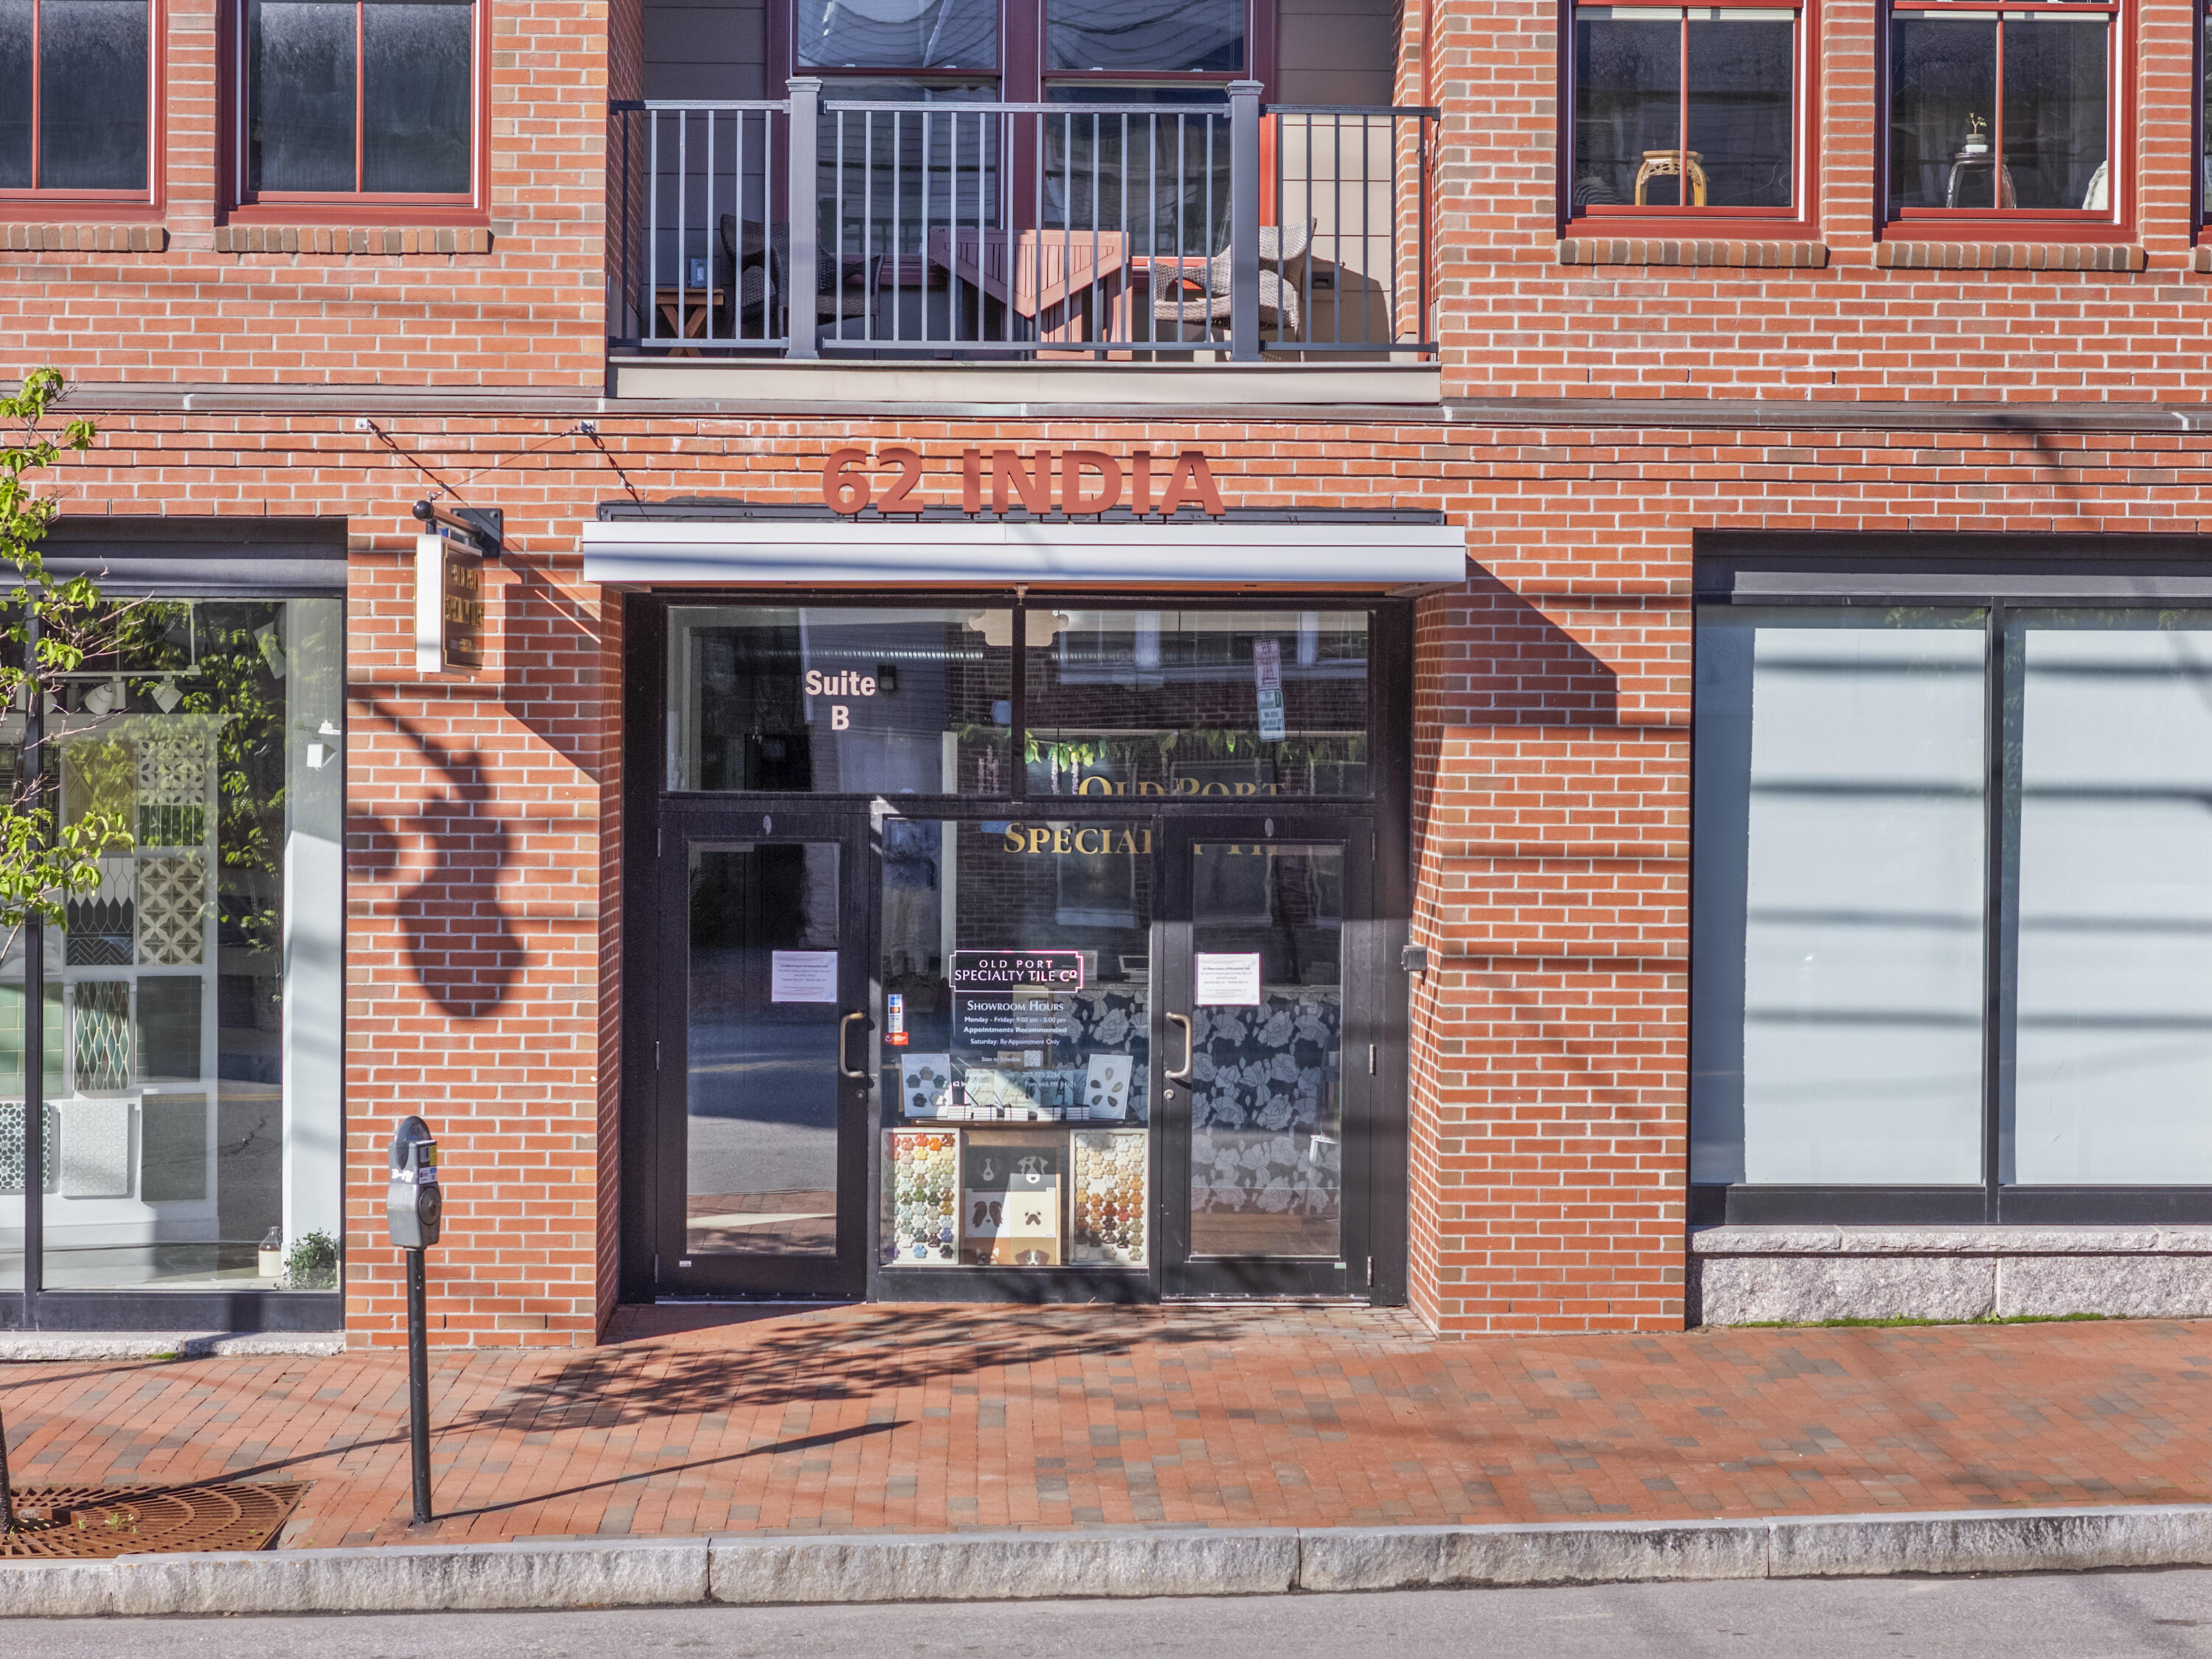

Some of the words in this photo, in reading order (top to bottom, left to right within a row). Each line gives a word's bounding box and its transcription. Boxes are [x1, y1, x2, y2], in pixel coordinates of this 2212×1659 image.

[822, 448, 925, 515] 62
[962, 448, 1226, 516] INDIA
[804, 669, 877, 696] Suite
[831, 705, 850, 731] B
[978, 959, 1008, 969] OLD
[1016, 959, 1054, 969] PORT
[954, 970, 1025, 981] SPECIALTY
[1028, 970, 1055, 982] TILE
[964, 1016, 989, 1024] Monday
[963, 1026, 1014, 1034] Appointments
[1000, 1038, 1008, 1046] By
[1008, 1038, 1045, 1046] Appointment
[1046, 1038, 1060, 1046] Only
